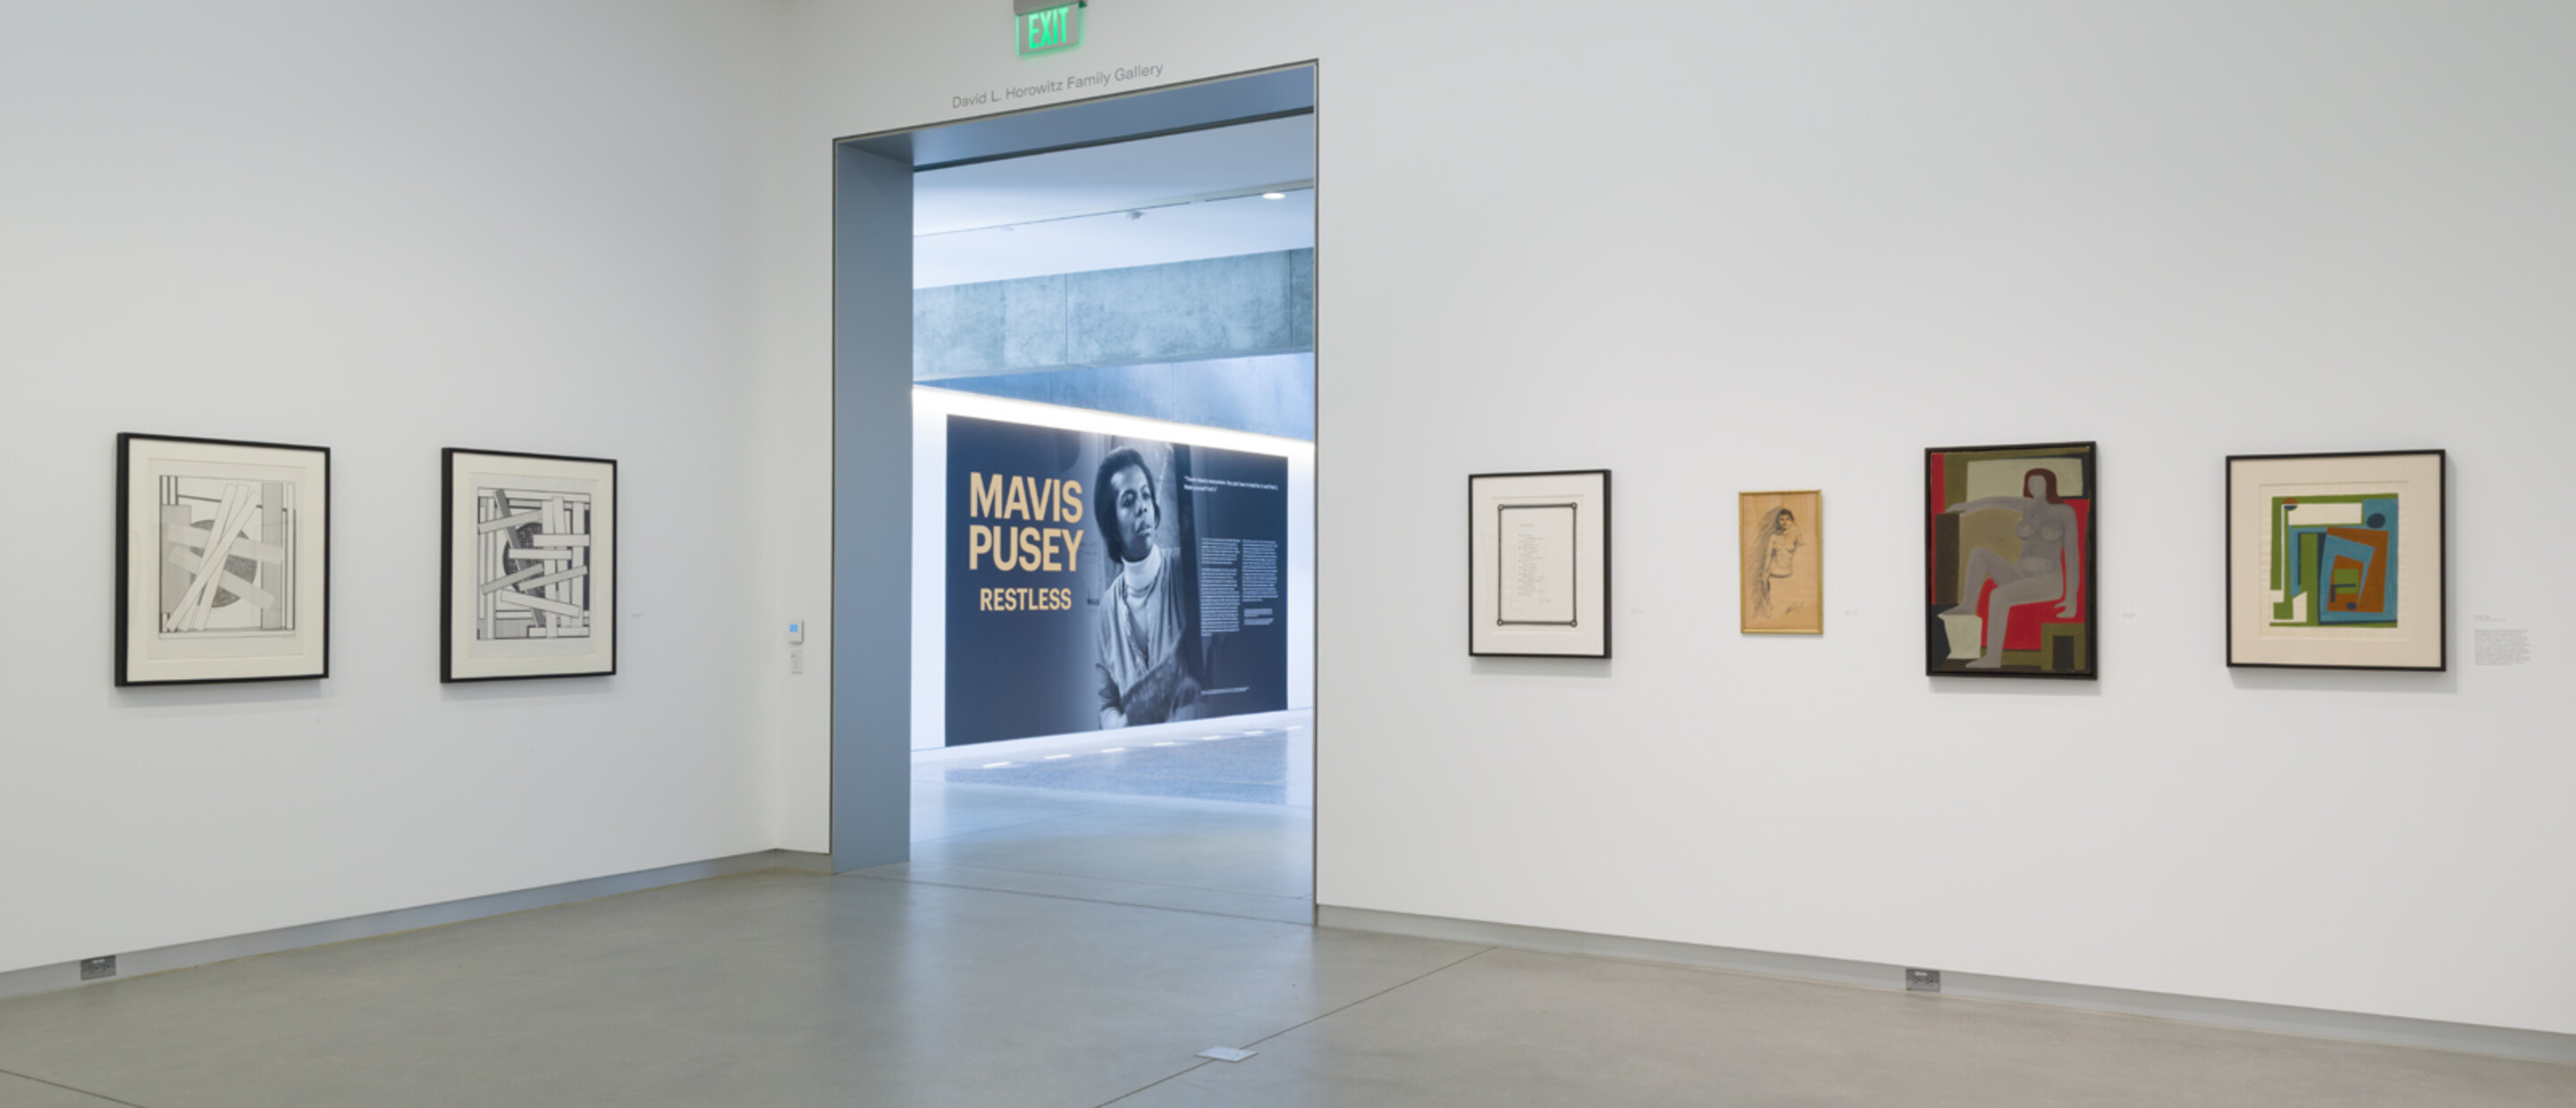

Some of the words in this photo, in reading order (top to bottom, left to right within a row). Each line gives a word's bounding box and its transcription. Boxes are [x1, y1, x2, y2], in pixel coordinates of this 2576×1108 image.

[1028, 6, 1070, 49] EXIT
[952, 93, 987, 109] David
[990, 90, 1001, 103] L.
[1006, 80, 1064, 100] Horowitz
[1067, 71, 1112, 89] Family
[1115, 64, 1164, 82] Gallery
[970, 472, 1083, 524] MAVIS
[969, 525, 1084, 572] PUSEY
[980, 587, 1072, 611] RESTLESS
